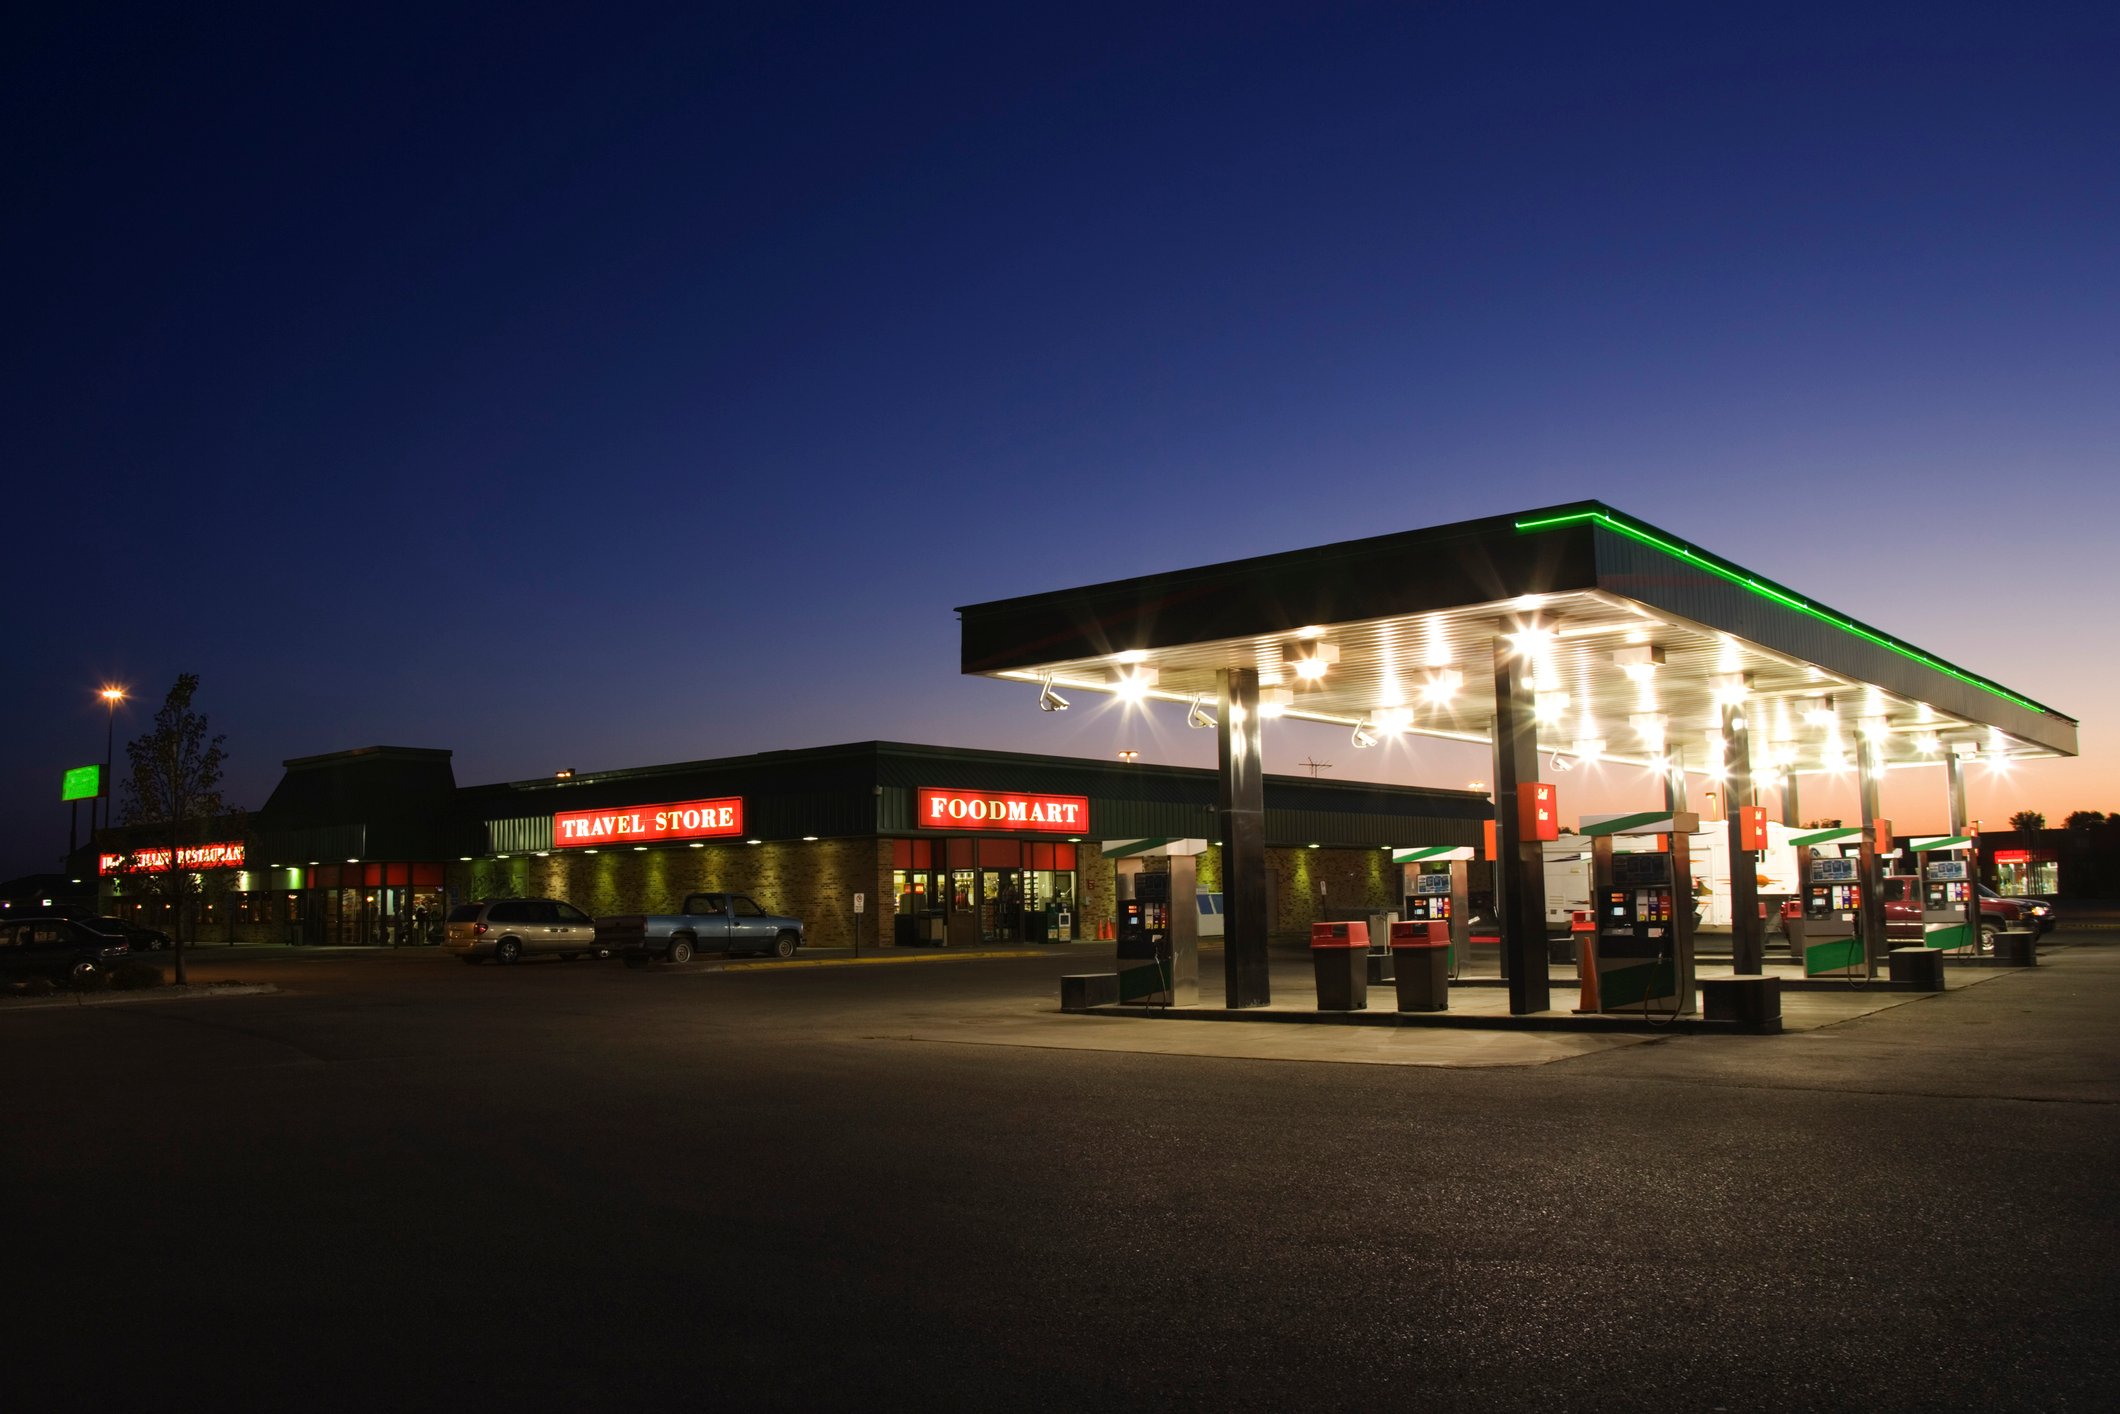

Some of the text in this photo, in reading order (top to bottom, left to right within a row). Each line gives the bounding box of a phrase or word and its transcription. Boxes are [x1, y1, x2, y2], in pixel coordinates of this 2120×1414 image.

[562, 807, 734, 837] TRAVEL STORE
[930, 797, 1079, 822] FOODMART
